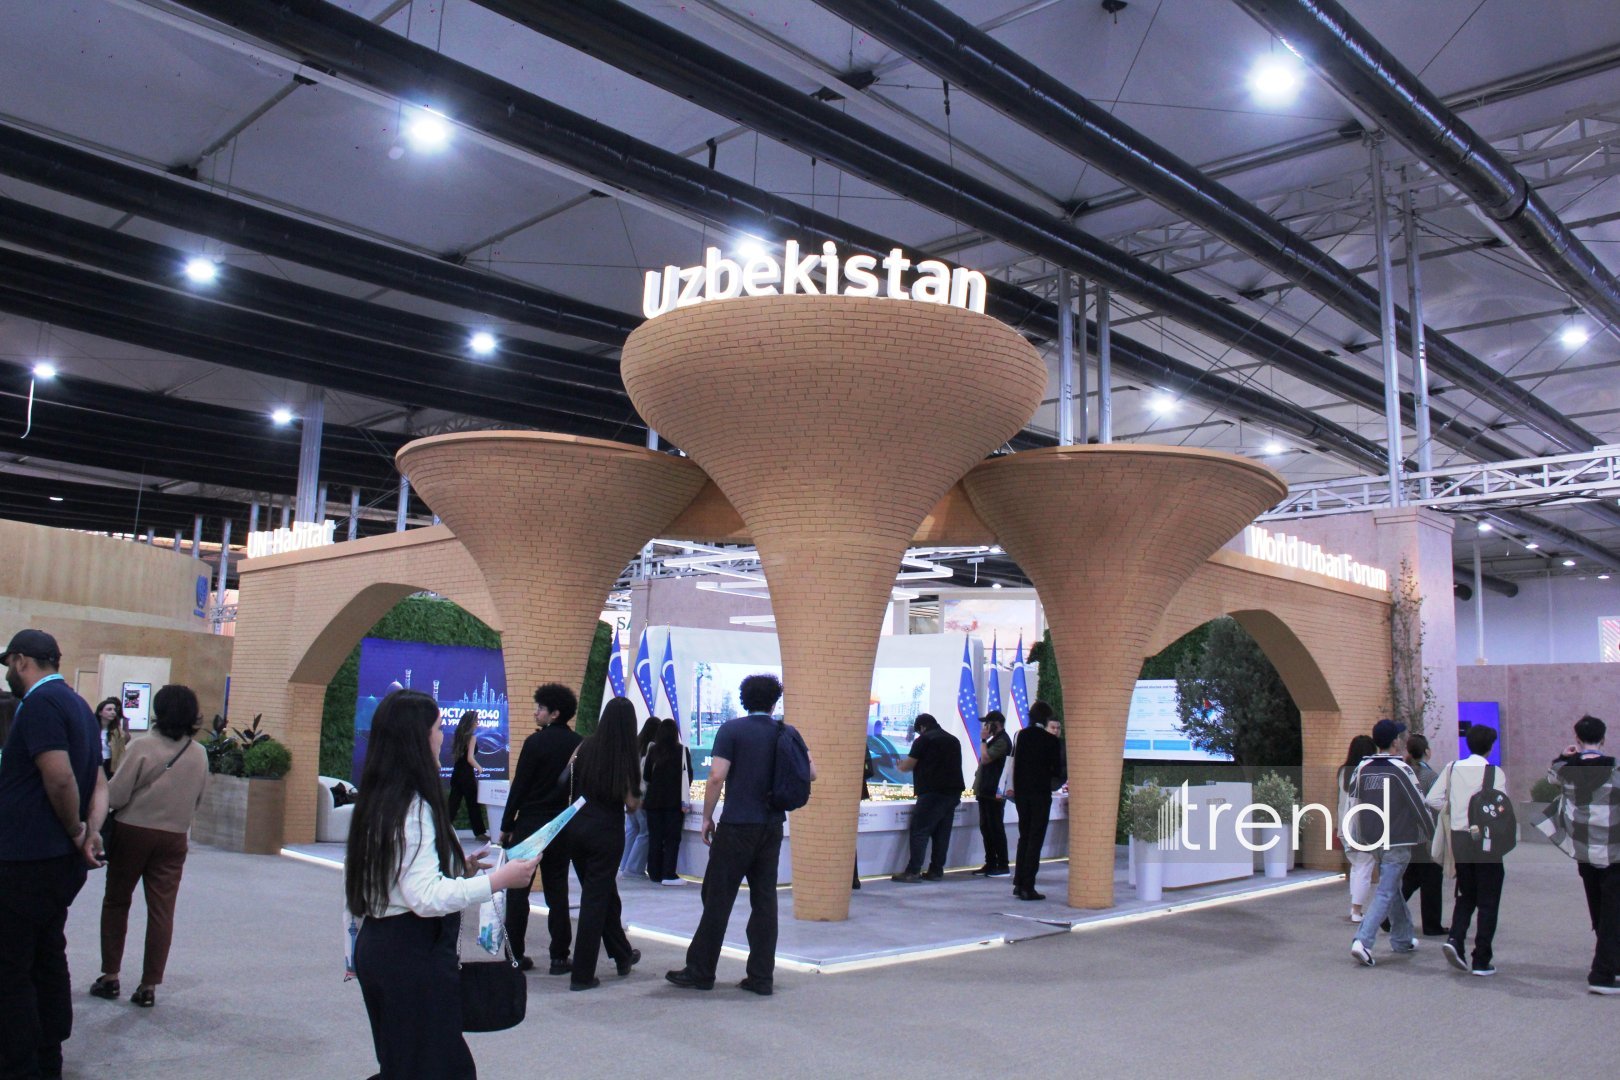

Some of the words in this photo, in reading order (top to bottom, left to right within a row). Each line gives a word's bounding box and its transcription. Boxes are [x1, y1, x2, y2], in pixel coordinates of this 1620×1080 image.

[247, 519, 335, 559] UN-Habitat
[1245, 525, 1298, 568] World
[1299, 541, 1341, 579] Urban
[1341, 554, 1387, 590] Forum
